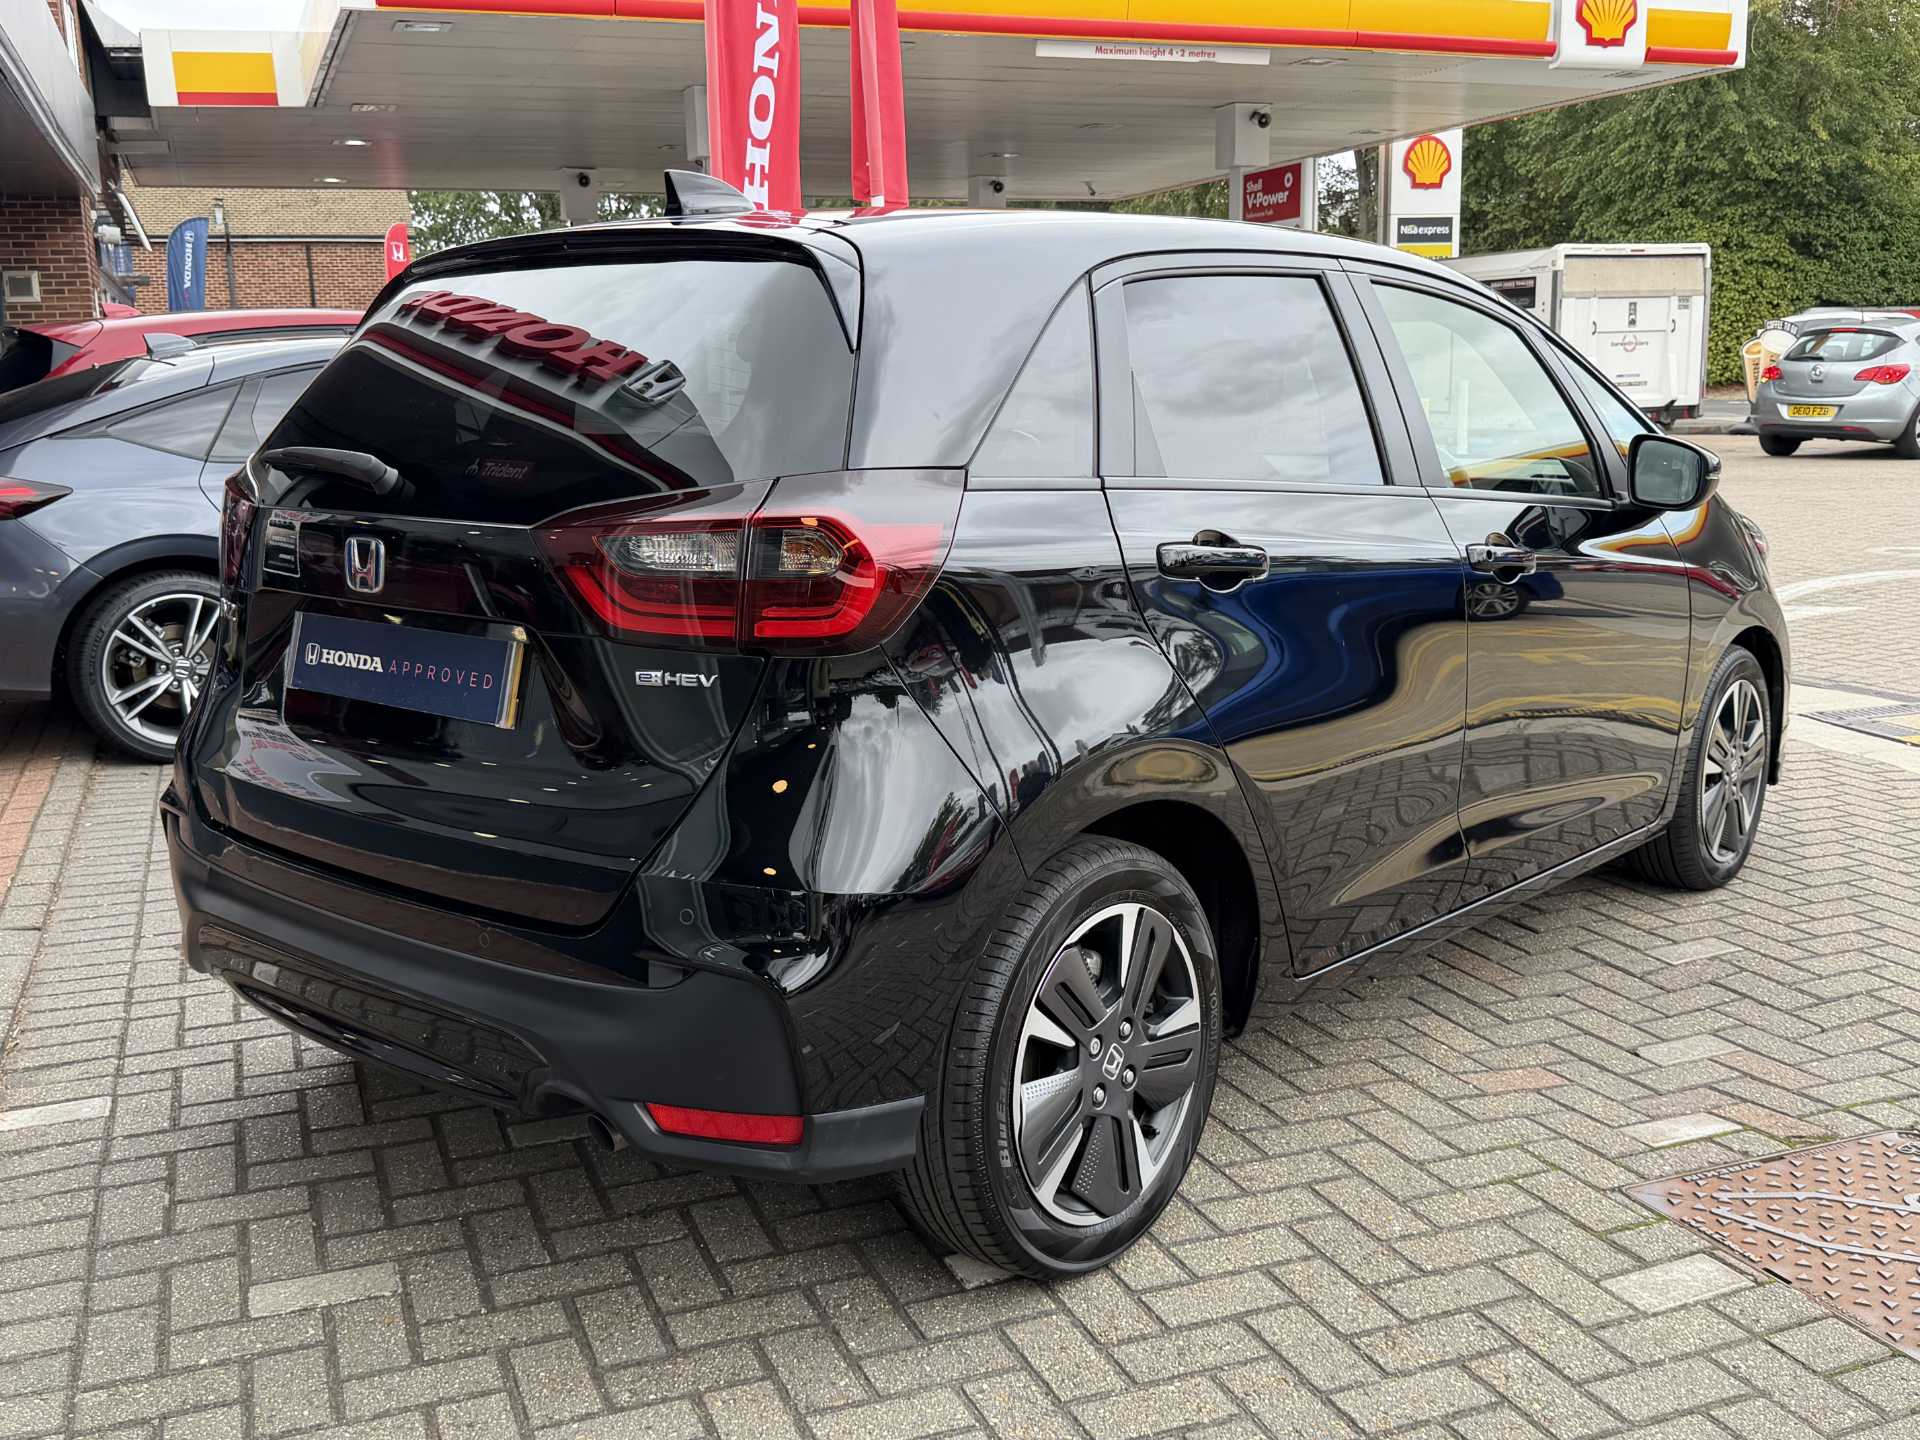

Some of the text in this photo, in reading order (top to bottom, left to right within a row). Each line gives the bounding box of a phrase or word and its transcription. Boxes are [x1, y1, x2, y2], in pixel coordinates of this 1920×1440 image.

[1095, 45, 1138, 56] Maximum
[1140, 46, 1166, 58] height
[1188, 49, 1217, 59] metres
[743, 0, 780, 210] HON
[1246, 179, 1263, 193] Shell
[481, 462, 528, 479] Trident
[320, 648, 494, 689] HONDA APPROVED
